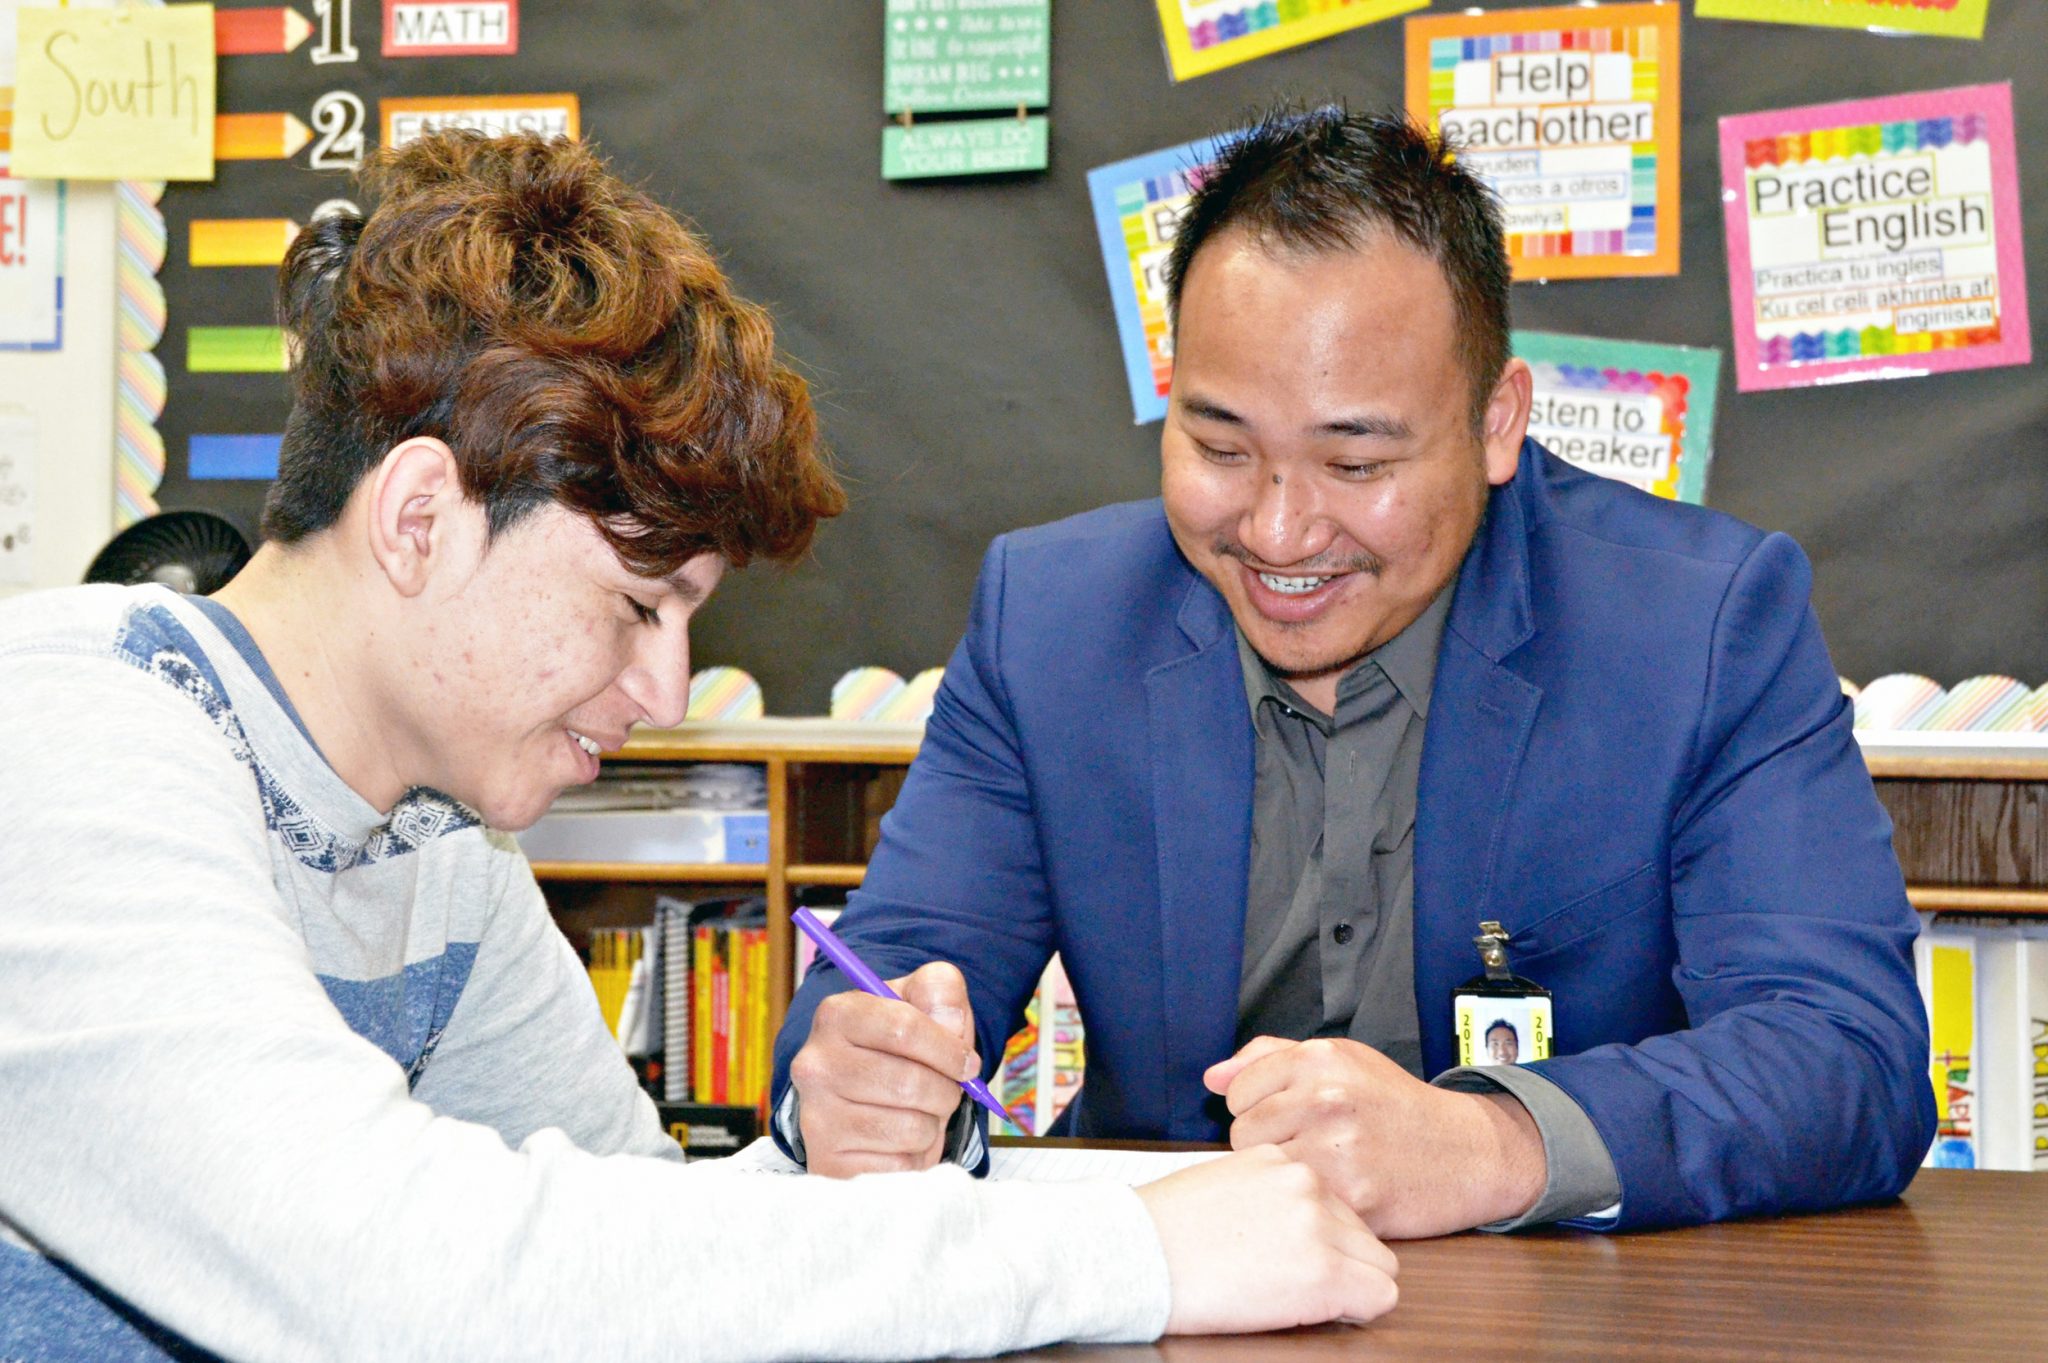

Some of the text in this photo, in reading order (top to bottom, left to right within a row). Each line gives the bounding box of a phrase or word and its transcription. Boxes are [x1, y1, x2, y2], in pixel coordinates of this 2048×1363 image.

[396, 9, 503, 42] MATH
[41, 29, 200, 141] South
[1496, 56, 1590, 98] Help
[310, 90, 366, 170] 2
[900, 129, 995, 152] ALWAYS
[1569, 177, 1619, 194] otros
[1753, 164, 1932, 213] Practice
[1823, 198, 1986, 252] English
[1757, 267, 1844, 289] Practica
[1849, 264, 1870, 281] tu
[1761, 301, 1789, 319] Ku
[1613, 401, 1645, 433] to
[1537, 435, 1665, 470] peaker
[1535, 1016, 1544, 1057] 201
[1937, 1050, 1974, 1142] Hayat
